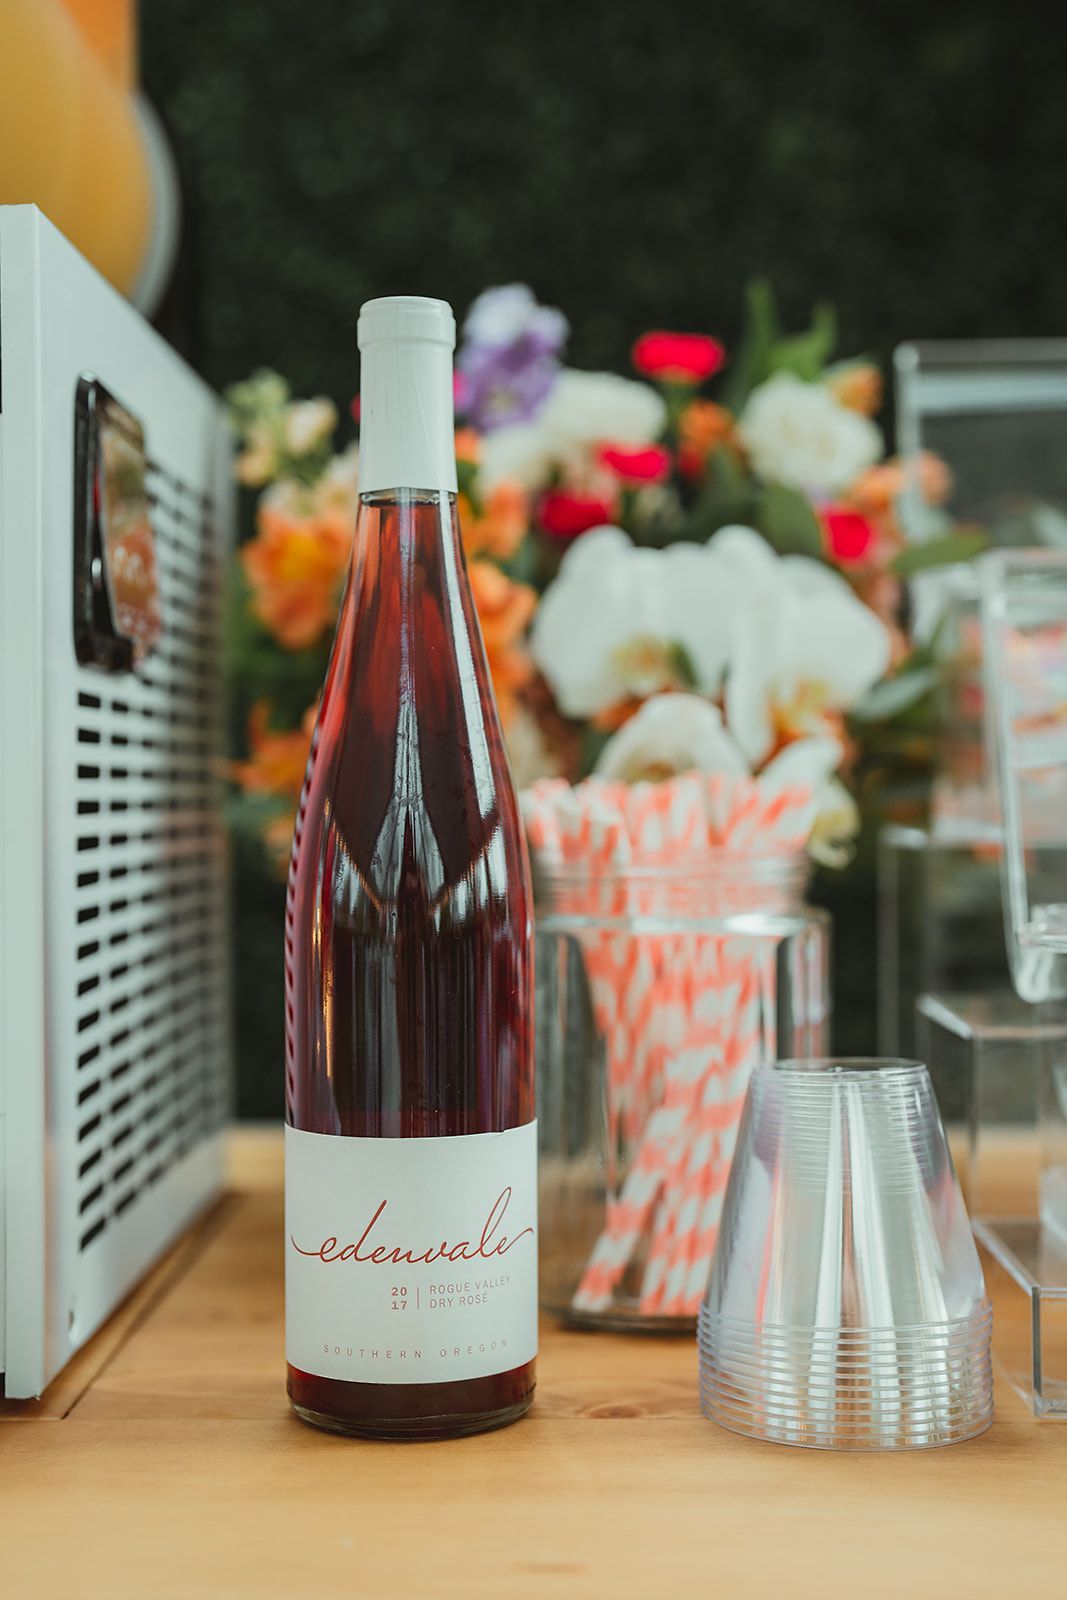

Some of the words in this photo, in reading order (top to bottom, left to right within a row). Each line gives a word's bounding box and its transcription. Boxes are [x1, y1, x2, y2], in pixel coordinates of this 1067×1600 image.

[290, 1186, 535, 1264] edenvale
[391, 1286, 408, 1297] 20
[429, 1283, 471, 1295] ROGUE
[475, 1276, 510, 1291] VALLEY
[391, 1300, 408, 1310] 17
[429, 1298, 453, 1309] DRY
[323, 1344, 423, 1359] SOUTHERN
[440, 1339, 508, 1358] OREGON
